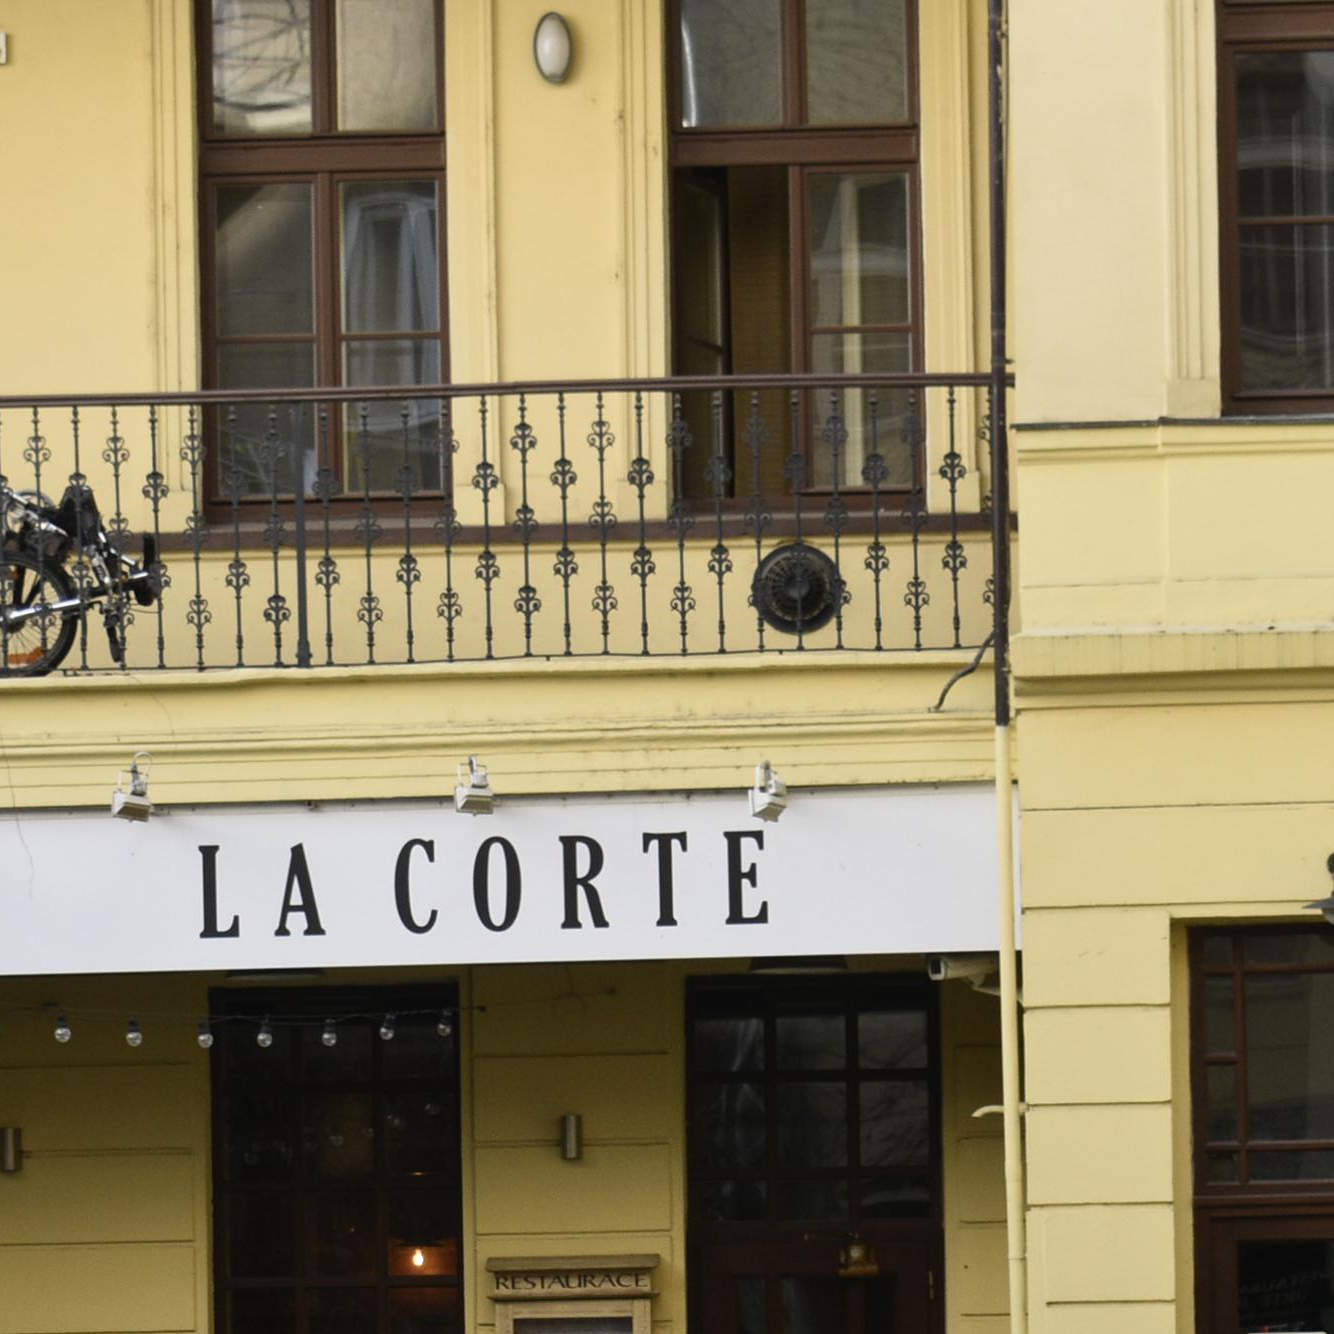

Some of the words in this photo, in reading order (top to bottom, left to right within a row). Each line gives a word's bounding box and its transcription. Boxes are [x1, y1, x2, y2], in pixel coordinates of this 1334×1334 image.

[197, 842, 327, 940] LA
[393, 829, 770, 935] CORTE
[495, 1272, 648, 1290] RESTAURACE
